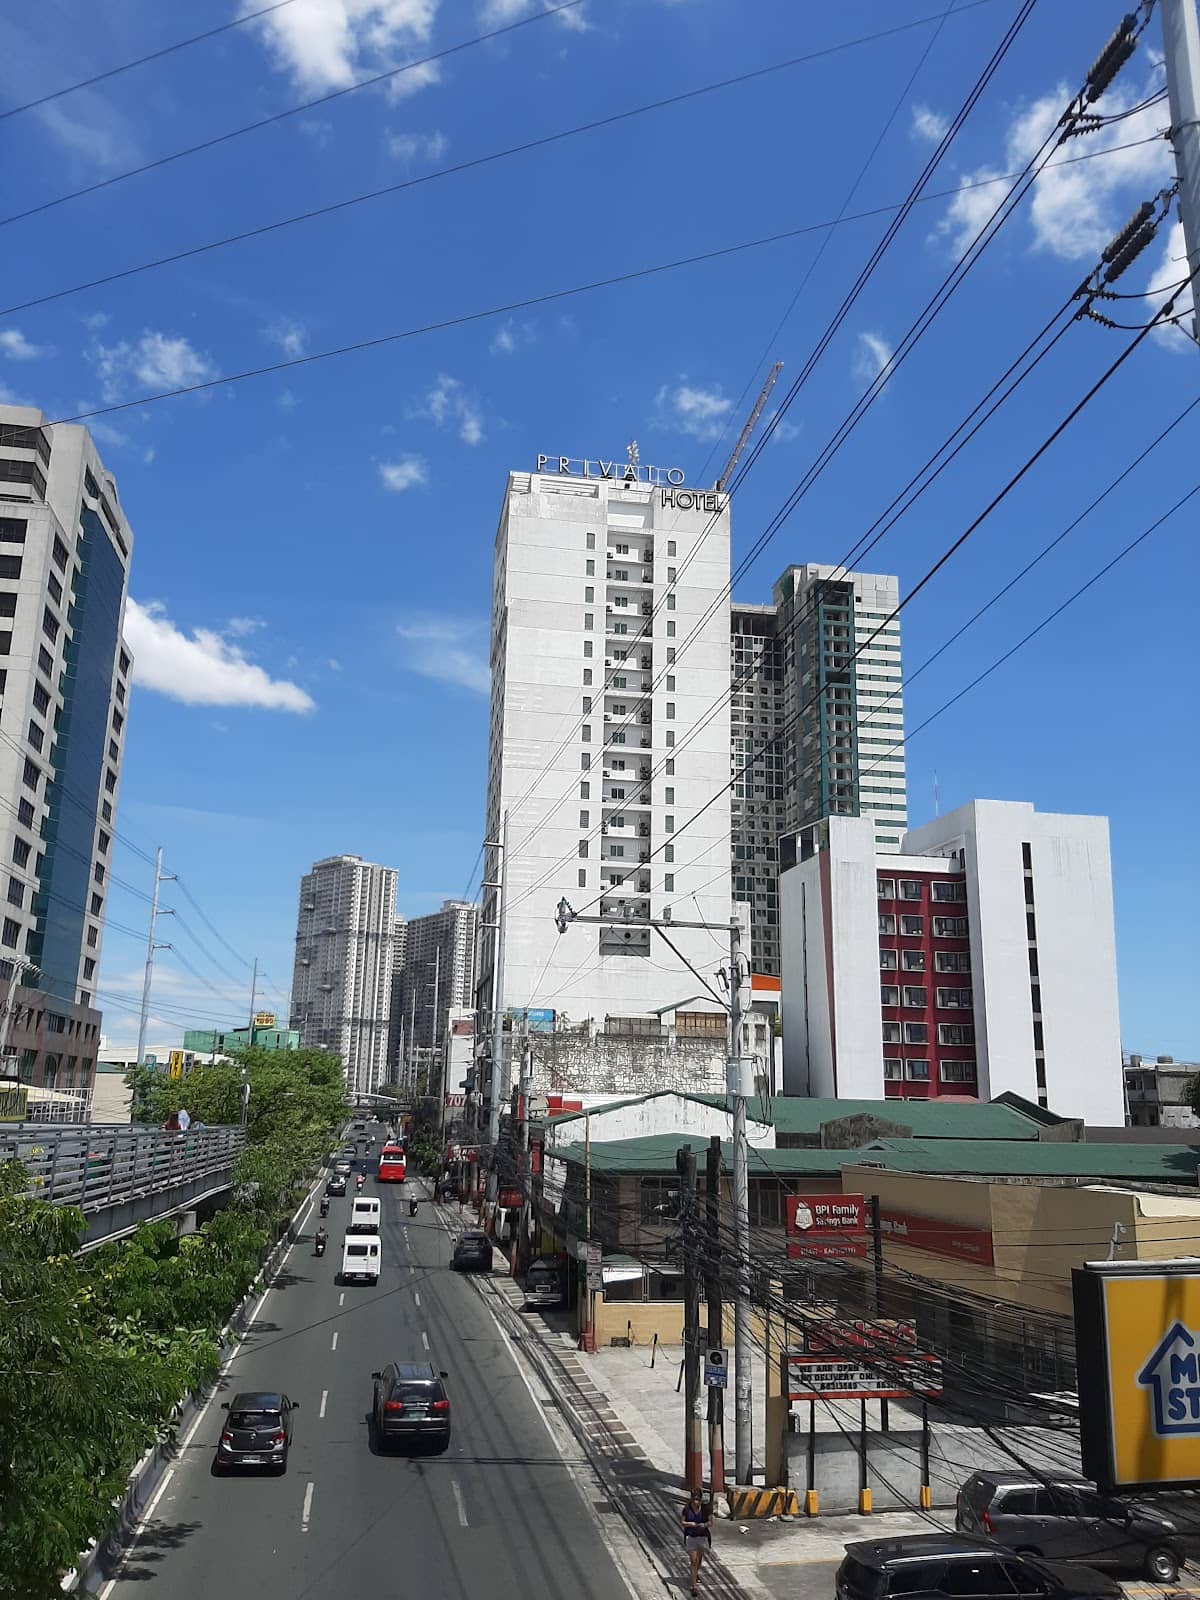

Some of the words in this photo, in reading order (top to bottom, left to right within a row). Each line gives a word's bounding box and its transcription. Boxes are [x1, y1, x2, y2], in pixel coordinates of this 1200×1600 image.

[537, 454, 685, 486] PRIVATO
[661, 488, 722, 513] HOTEL
[815, 1205, 829, 1215] BPI
[832, 1203, 859, 1216] Family
[841, 1215, 858, 1224] Bank
[1171, 1353, 1200, 1384] M
